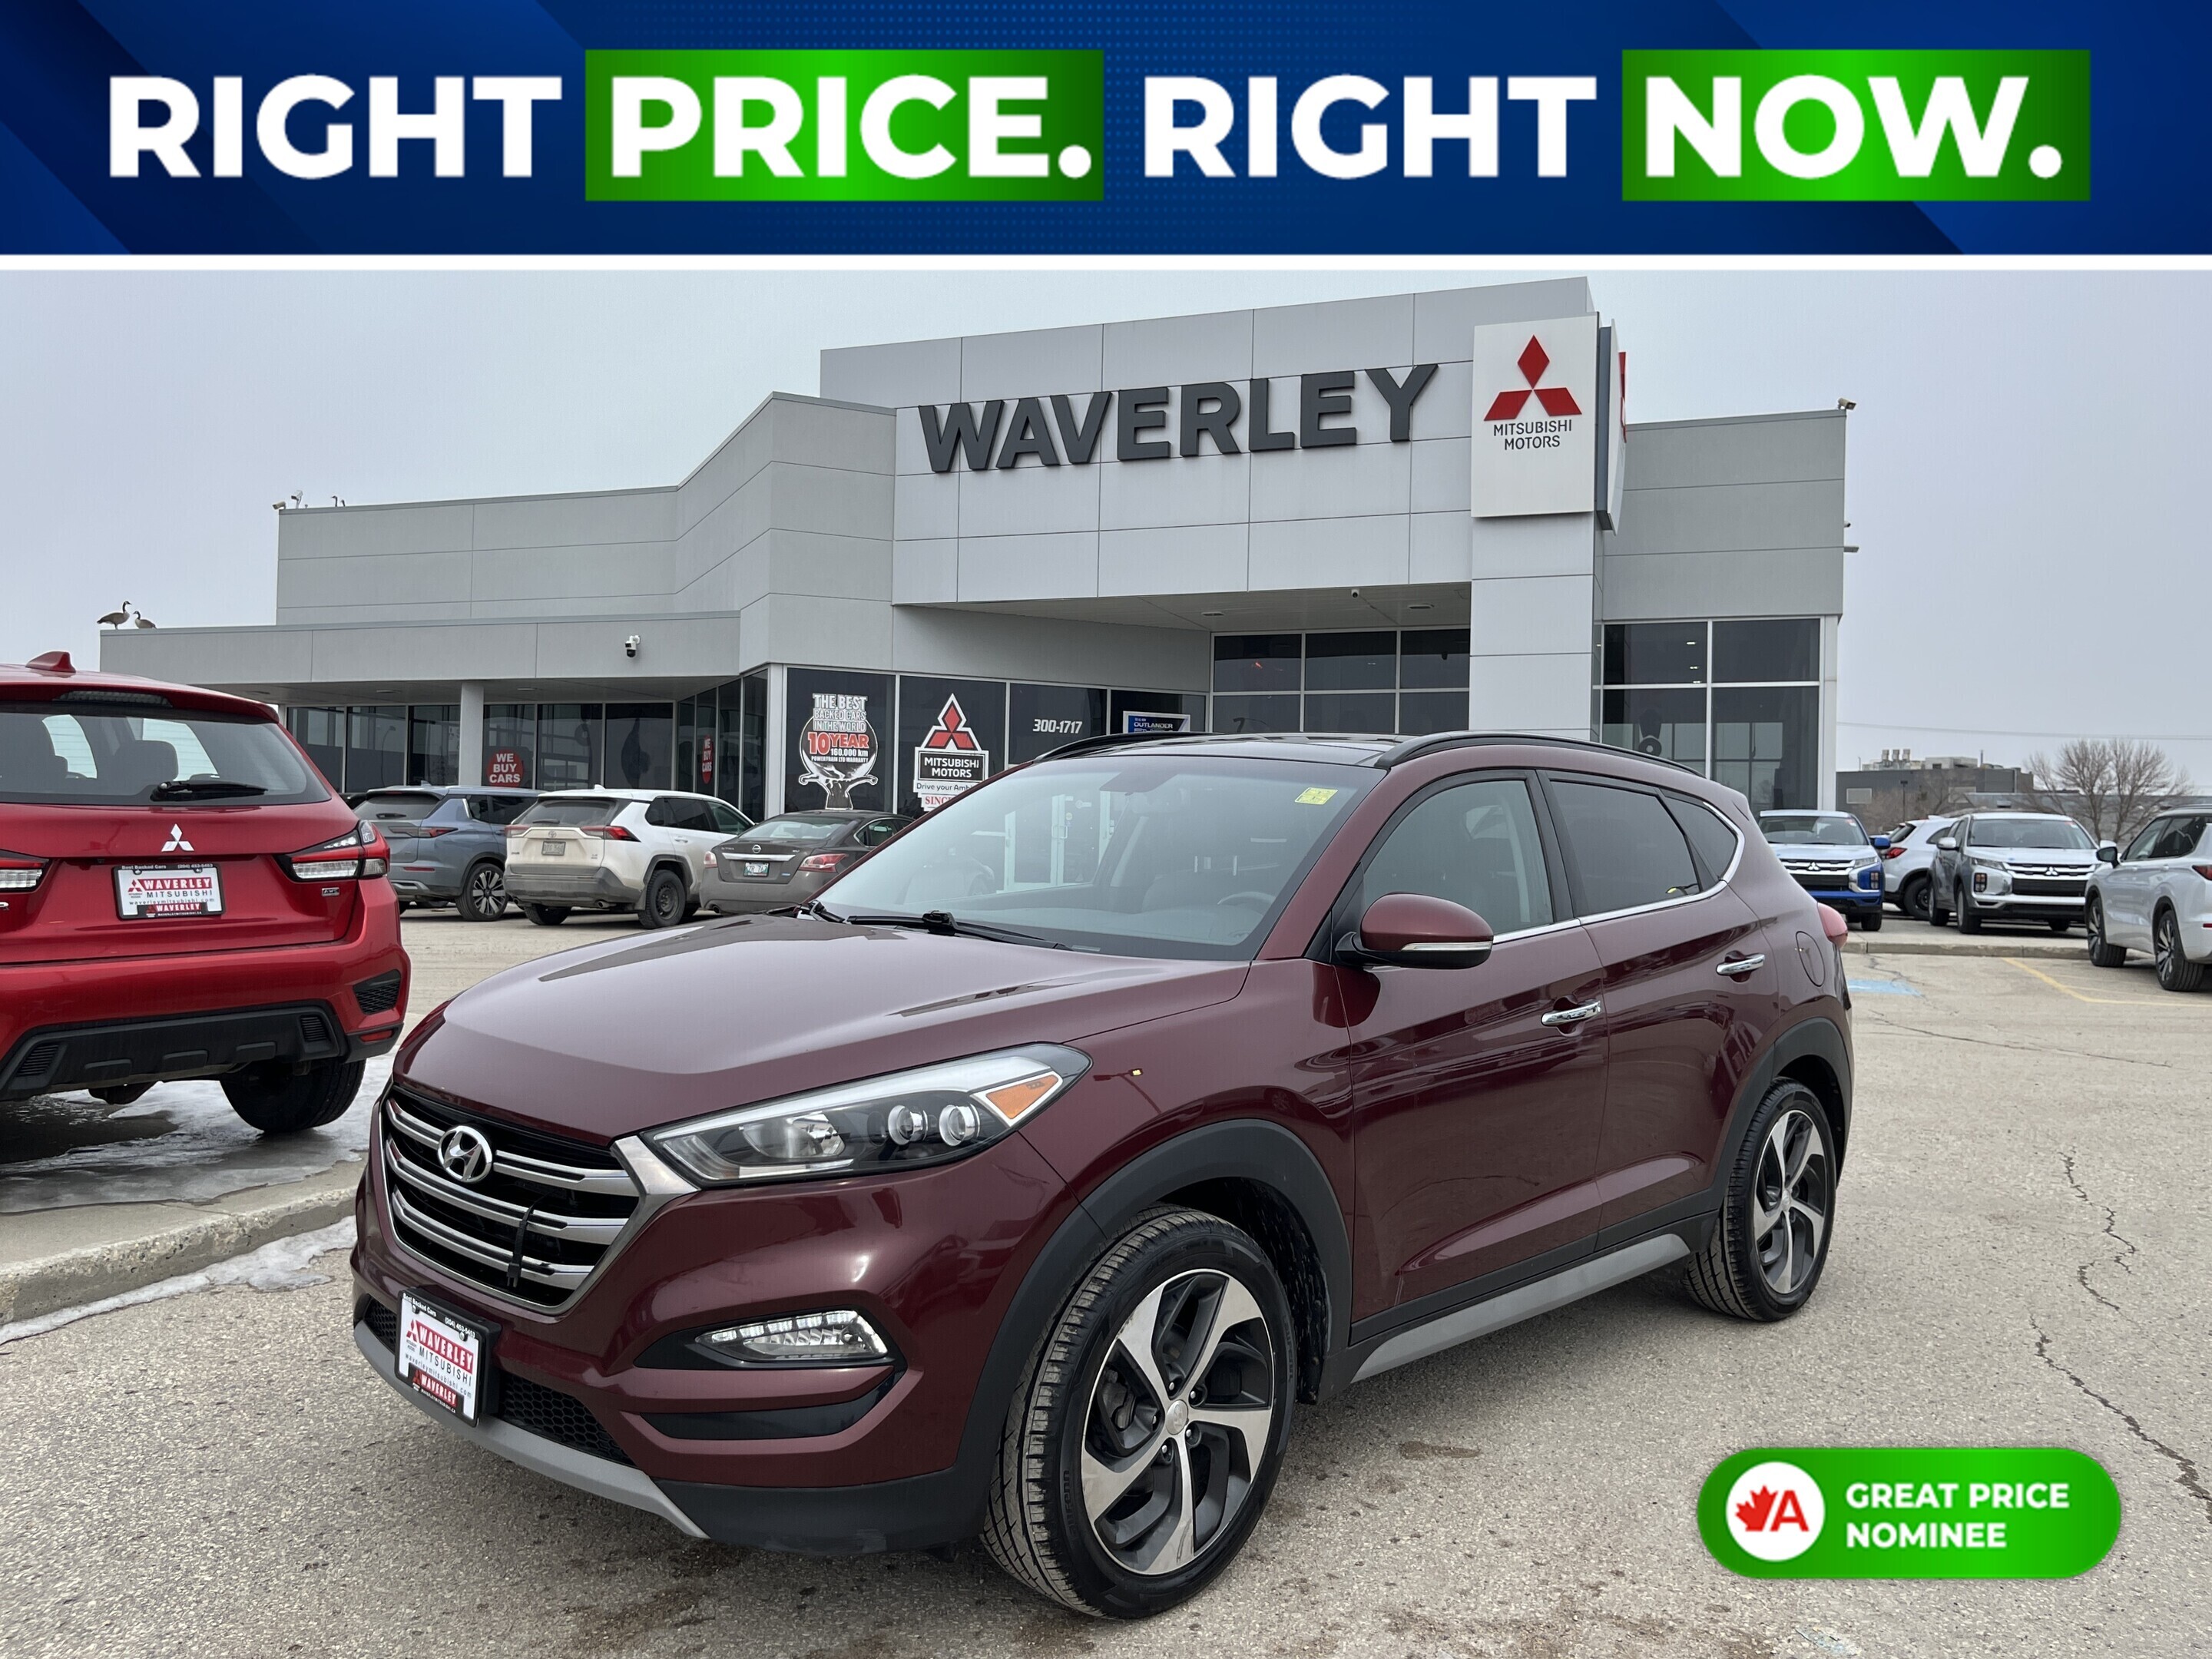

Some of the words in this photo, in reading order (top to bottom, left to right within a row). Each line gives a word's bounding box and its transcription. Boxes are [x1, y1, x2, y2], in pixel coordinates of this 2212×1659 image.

[918, 363, 1439, 473] WAVERLEY
[1493, 419, 1572, 436] MITSUBISHI
[1504, 435, 1560, 450] MOTORS
[813, 694, 836, 708] THE
[838, 694, 867, 710] BEST
[814, 709, 845, 720] BACKED
[846, 710, 866, 721] CARS
[814, 720, 823, 730] IN
[823, 720, 838, 731] THE
[839, 721, 866, 732] WORLD
[1032, 718, 1083, 734] 300-1717
[808, 732, 830, 755] 10
[830, 733, 869, 748] YEAR
[496, 753, 514, 763] WE
[703, 750, 712, 761] BUY
[857, 749, 869, 757] km
[493, 763, 517, 773] BUY
[702, 762, 712, 773] CARS
[924, 757, 979, 768] MITSUBISHI
[489, 773, 521, 783] CARS
[932, 768, 972, 778] MOTORS
[925, 796, 952, 805] SINC
[144, 879, 210, 889] WAVERLEY
[156, 903, 200, 912] WAVERLEY
[427, 1306, 436, 1317] Cars
[419, 1325, 473, 1370] WAVERLEY
[419, 1346, 472, 1386] MITSUBISHI
[406, 1354, 472, 1398] waverleymitsubishi.com
[421, 1373, 456, 1405] WAVERLEY
